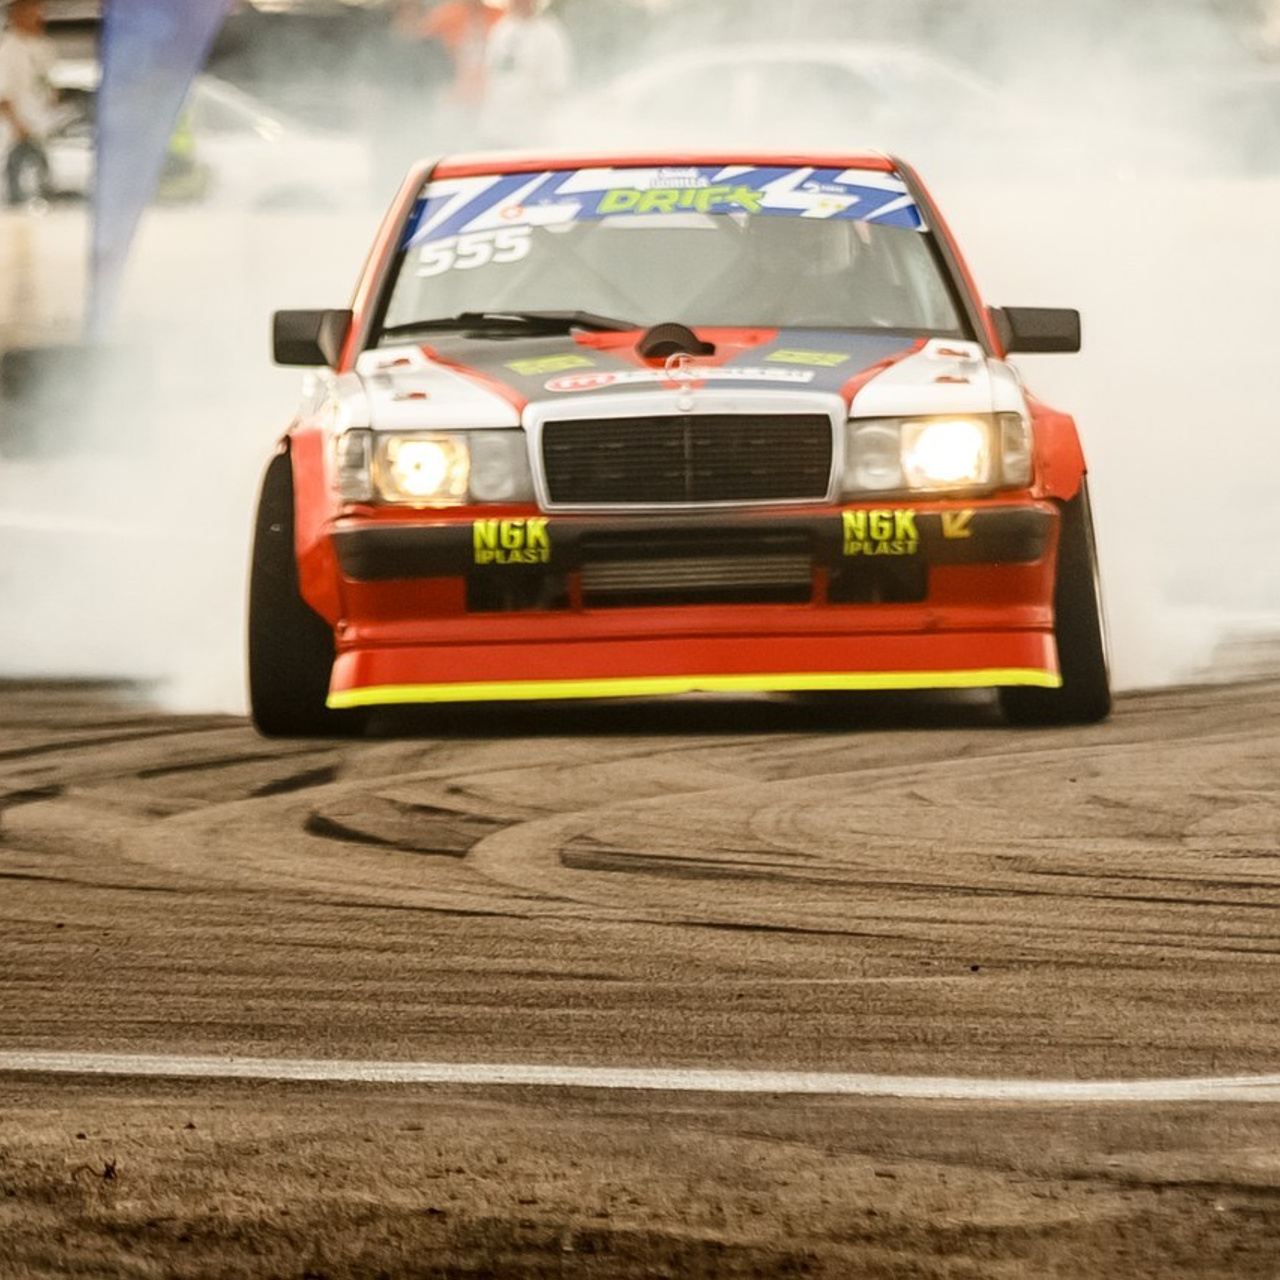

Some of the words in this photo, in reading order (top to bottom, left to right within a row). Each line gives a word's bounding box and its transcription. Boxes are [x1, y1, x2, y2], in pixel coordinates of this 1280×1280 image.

[416, 225, 532, 277] 555
[473, 517, 549, 549] NGK
[842, 508, 918, 540] NGK
